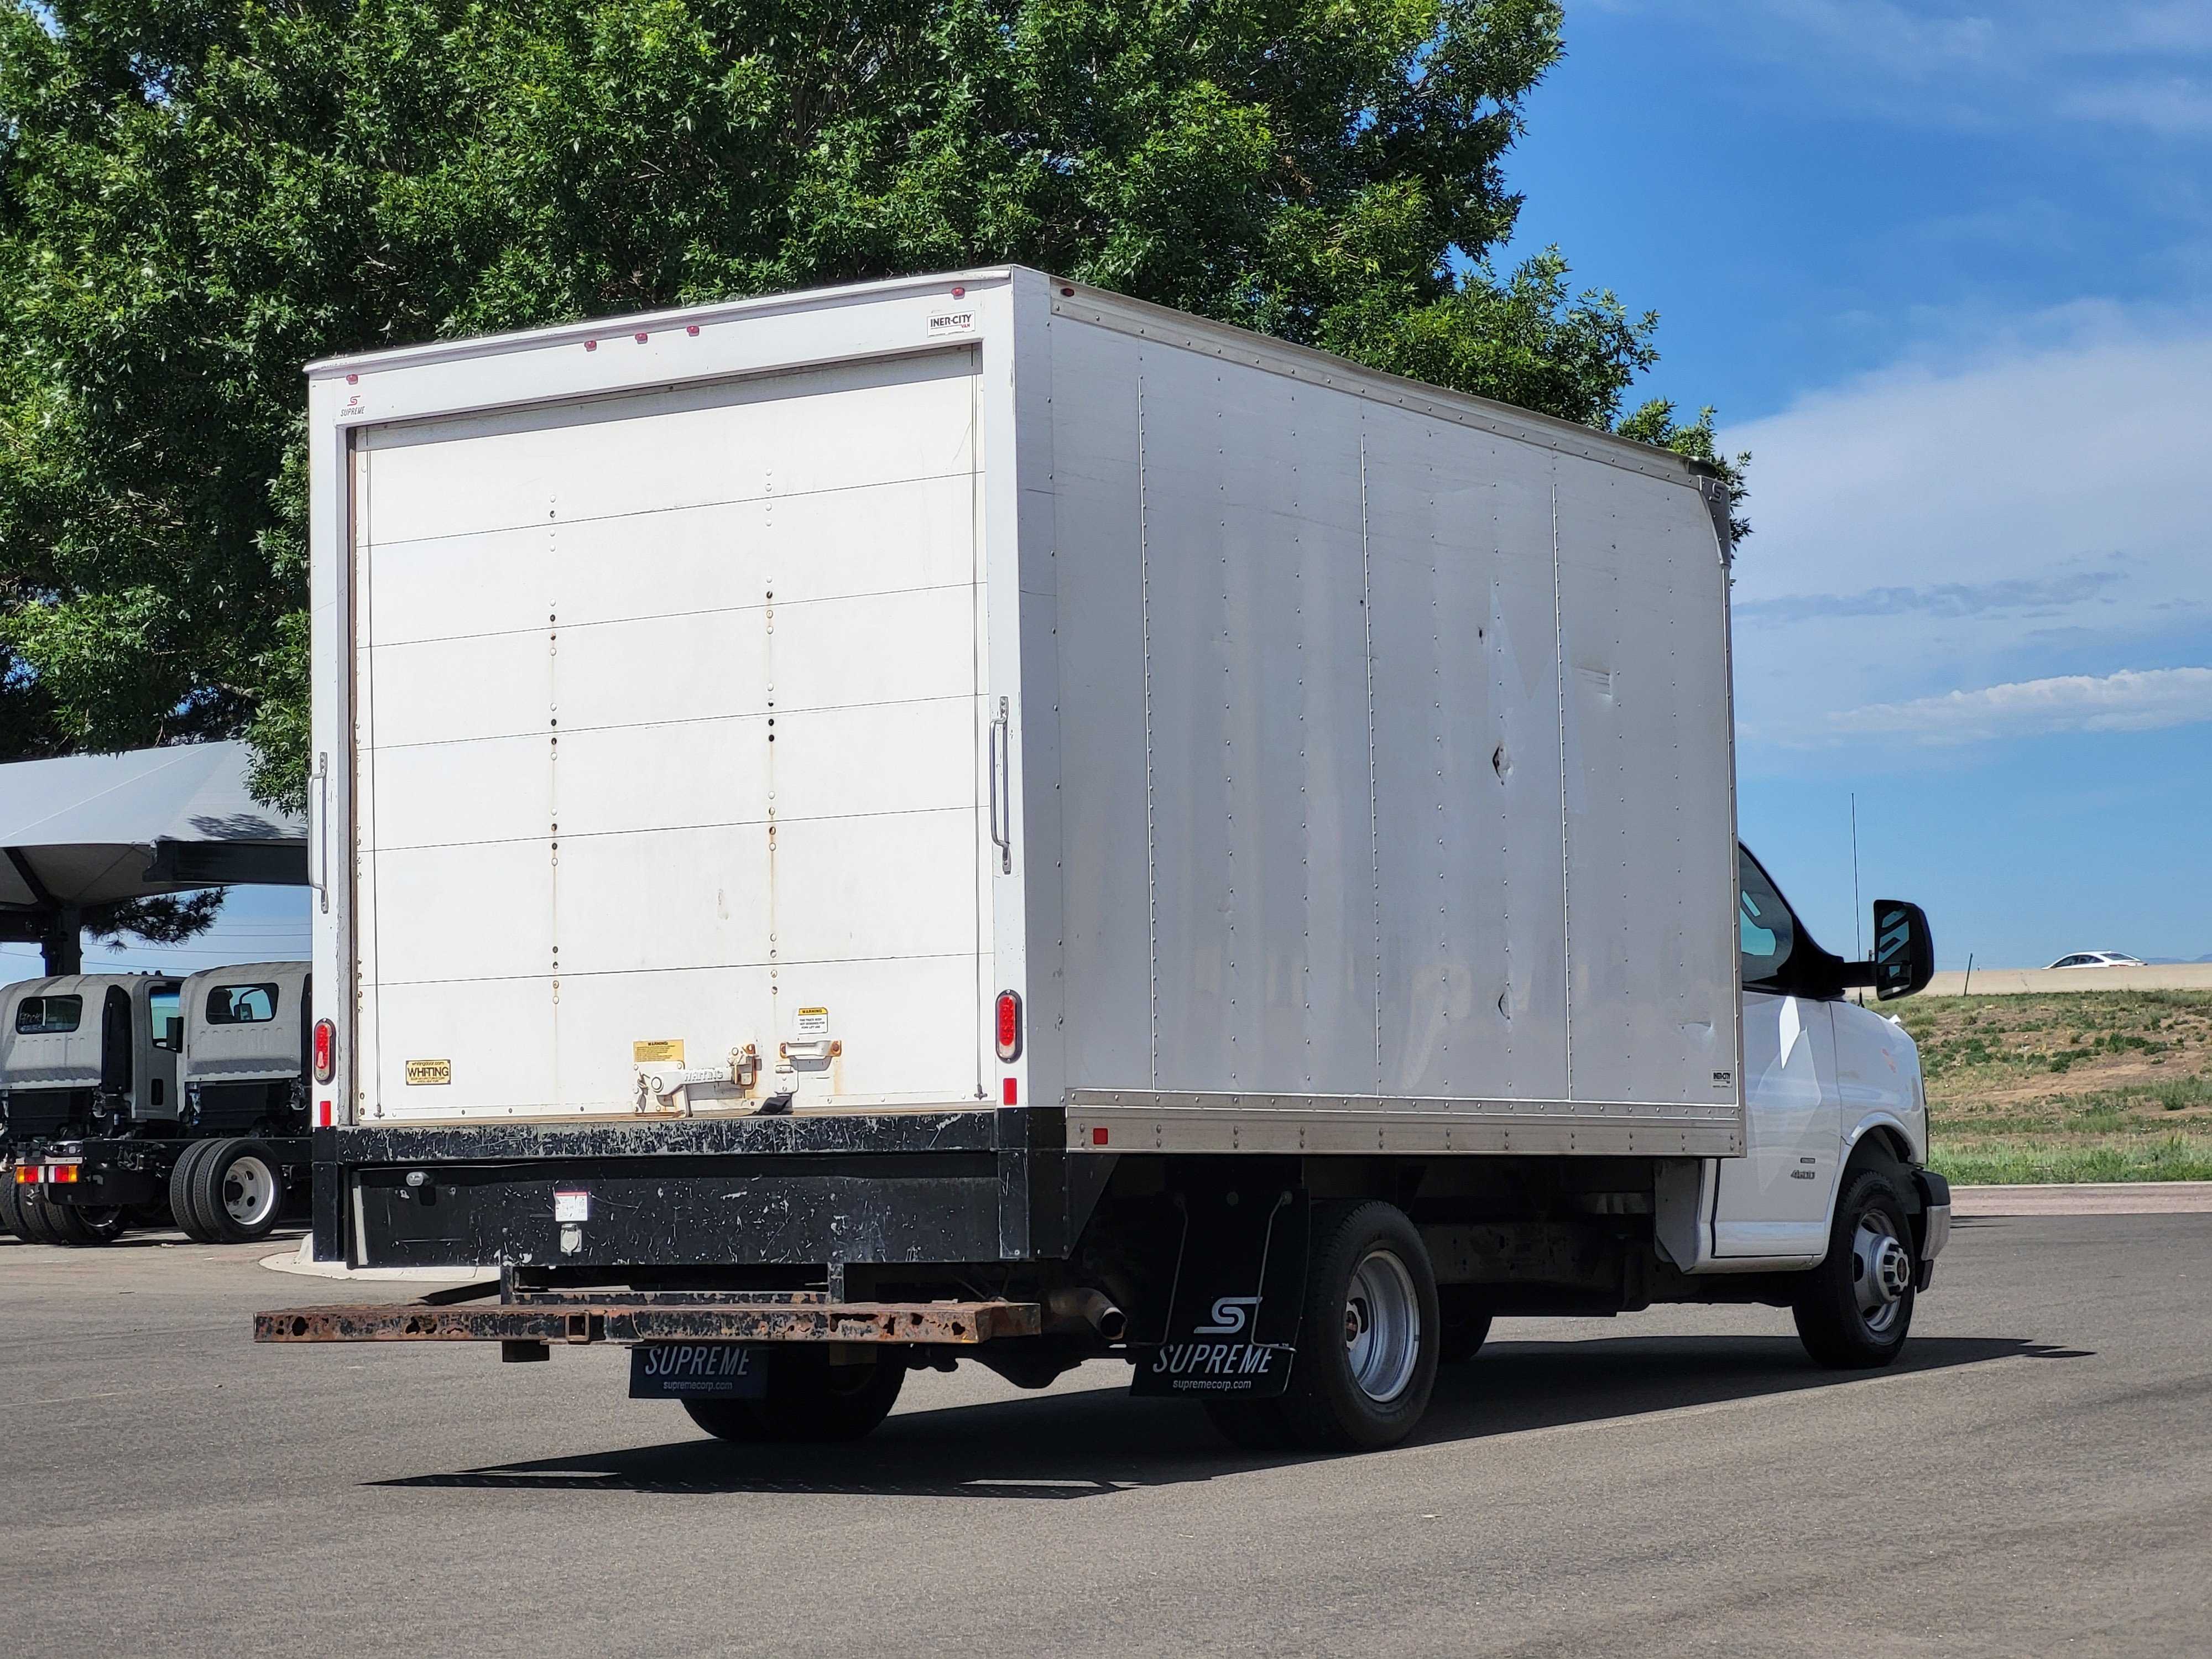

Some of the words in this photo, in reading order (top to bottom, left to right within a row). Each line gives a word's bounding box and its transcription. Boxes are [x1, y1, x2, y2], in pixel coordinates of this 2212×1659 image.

[930, 314, 972, 327] INER-CITY
[340, 406, 365, 417] SUPREME
[408, 1067, 448, 1077] WHITING
[645, 1345, 749, 1375] SUPREME
[1153, 1344, 1279, 1374] SUPREME
[663, 1381, 733, 1391] supremecorp.com
[1173, 1380, 1251, 1391] supremecorp.com
